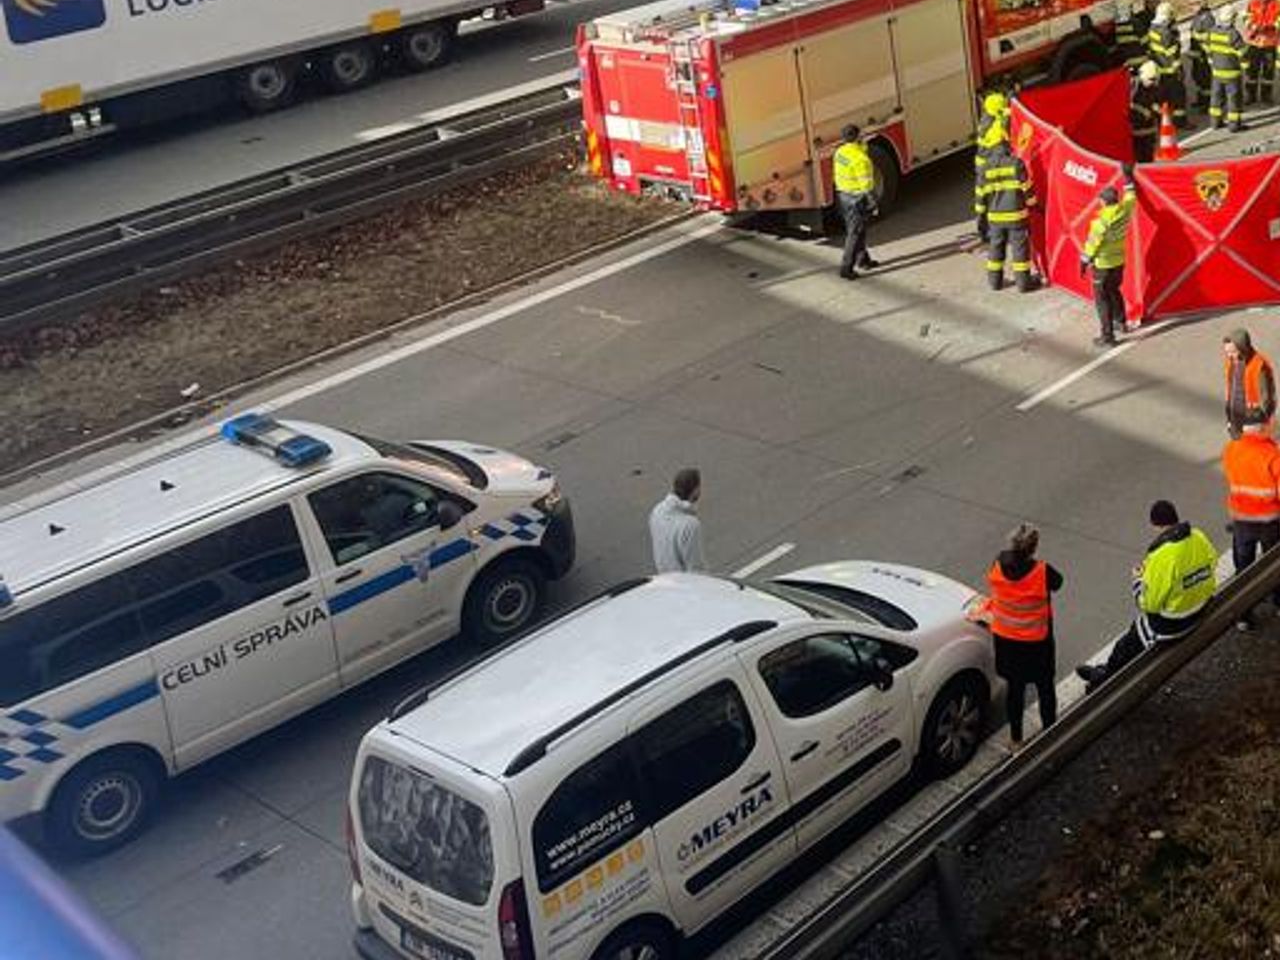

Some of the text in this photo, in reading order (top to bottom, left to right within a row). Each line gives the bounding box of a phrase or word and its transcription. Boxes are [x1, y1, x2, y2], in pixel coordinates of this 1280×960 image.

[161, 647, 229, 693] CELNÍ
[234, 606, 327, 661] SPRÁVA
[689, 787, 774, 852] MEYRA
